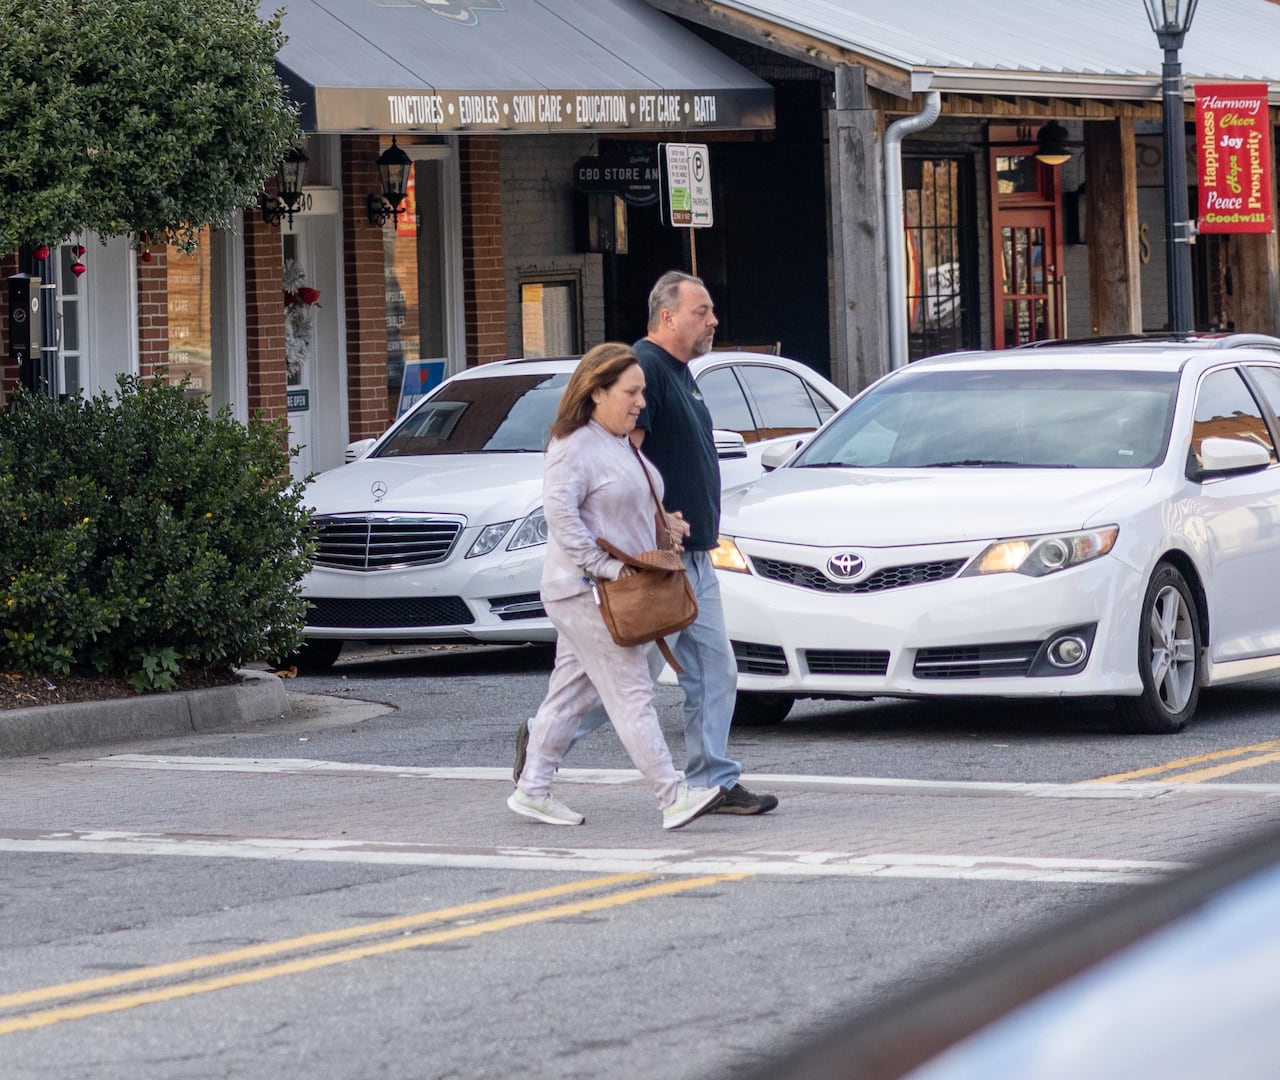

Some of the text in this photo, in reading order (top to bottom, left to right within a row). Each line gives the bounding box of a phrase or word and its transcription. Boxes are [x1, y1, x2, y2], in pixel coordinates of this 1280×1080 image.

[388, 95, 717, 125] TINCTURES EDIBLES SKIN CARE EDUCATION PET CARE BATH
[1202, 95, 1261, 115] Harmony
[1219, 113, 1256, 128] Cheer
[1202, 111, 1219, 187] Happiness
[1220, 135, 1243, 149] Joy
[579, 168, 660, 181] CBD STORE AN
[1226, 155, 1242, 194] Hope
[1246, 129, 1263, 209] Prosperity
[1206, 191, 1242, 210] Peace
[1205, 212, 1265, 223] Goodwill
[294, 395, 306, 407] OPEN
